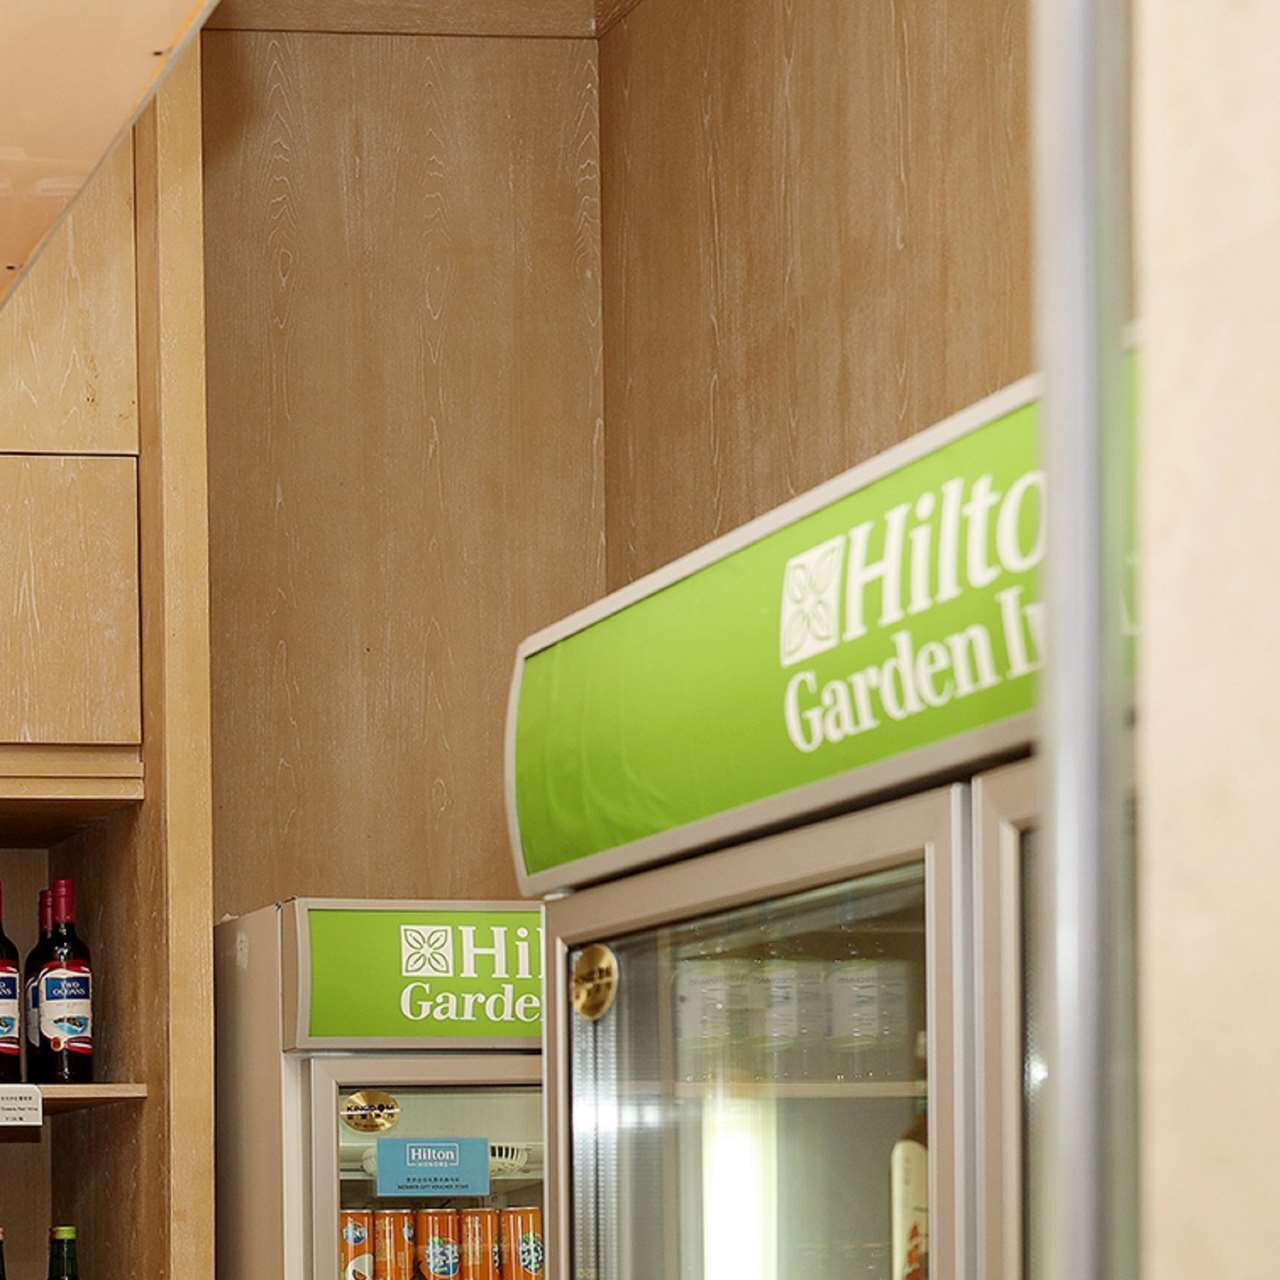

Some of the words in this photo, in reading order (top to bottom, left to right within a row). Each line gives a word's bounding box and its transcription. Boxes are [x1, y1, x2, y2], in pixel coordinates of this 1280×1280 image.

[784, 630, 1001, 753] Garden
[400, 981, 543, 1022] Garde
[411, 1147, 455, 1161] Hilton
